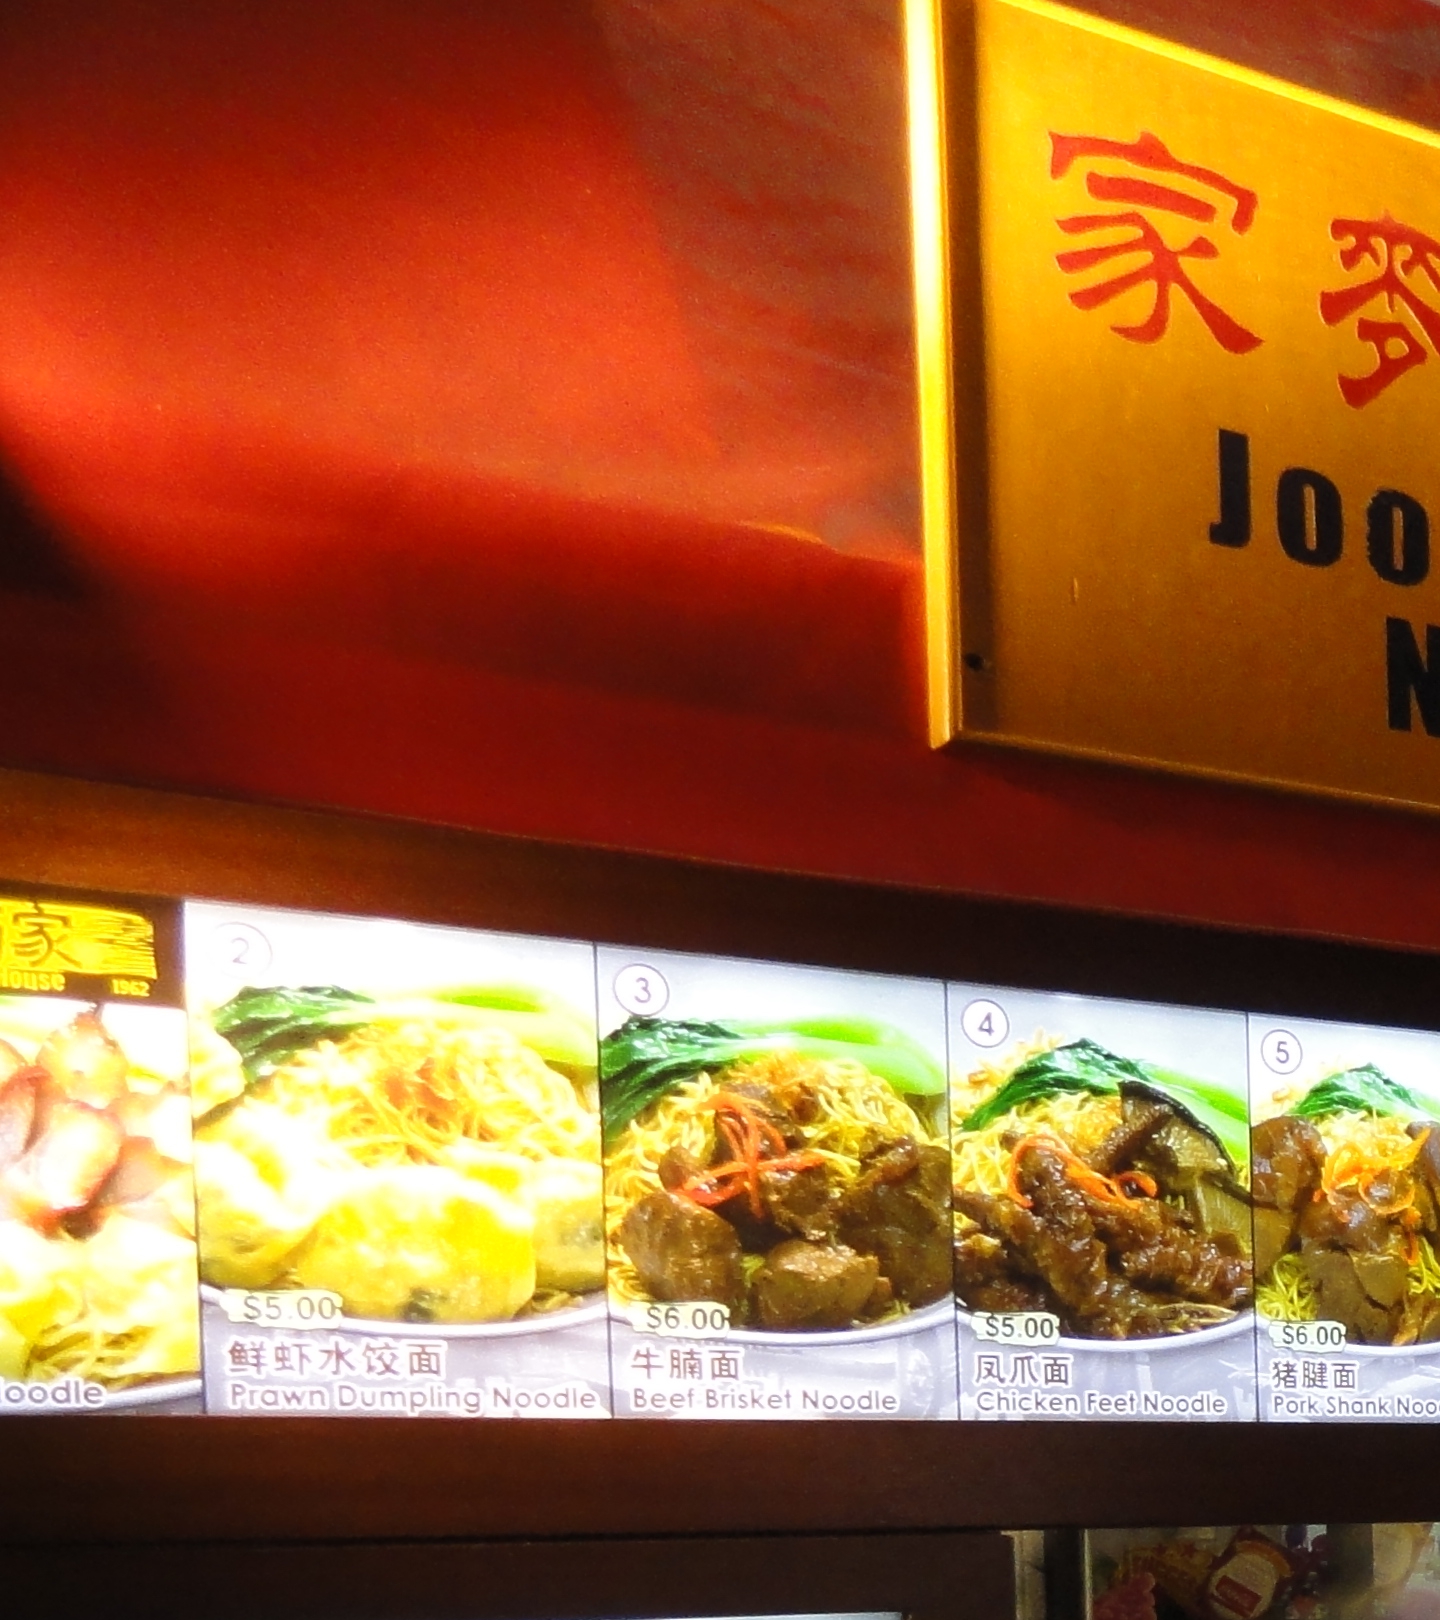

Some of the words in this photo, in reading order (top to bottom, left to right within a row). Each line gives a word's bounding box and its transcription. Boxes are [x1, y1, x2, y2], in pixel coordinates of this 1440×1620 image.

[1207, 427, 1432, 590] Joo
[229, 936, 252, 966] 2
[112, 978, 150, 997] 1962
[634, 977, 652, 1003] 3
[976, 1011, 995, 1039] 4
[1274, 1041, 1291, 1065] 5
[242, 1296, 338, 1321] $5.00
[646, 1306, 726, 1330] $6.00
[985, 1313, 1054, 1339] $5.00
[1282, 1325, 1343, 1346] $6.00
[229, 1341, 442, 1377] 鲜虾水饺面
[631, 1347, 741, 1381] 牛腩面
[974, 1354, 1071, 1386] 凤爪面
[0, 1380, 104, 1407] oodle
[231, 1385, 327, 1408] Prawn
[338, 1385, 481, 1414] Dumpling
[492, 1386, 598, 1410] Noodle
[633, 1388, 695, 1409] Beef
[705, 1388, 792, 1410] Brisket
[802, 1389, 898, 1411] Noodle
[976, 1391, 1079, 1413] Chicken
[1086, 1392, 1137, 1413] Feet
[1143, 1393, 1226, 1414] Noodle
[1273, 1395, 1322, 1415] Pork
[1325, 1396, 1391, 1416] Shank
